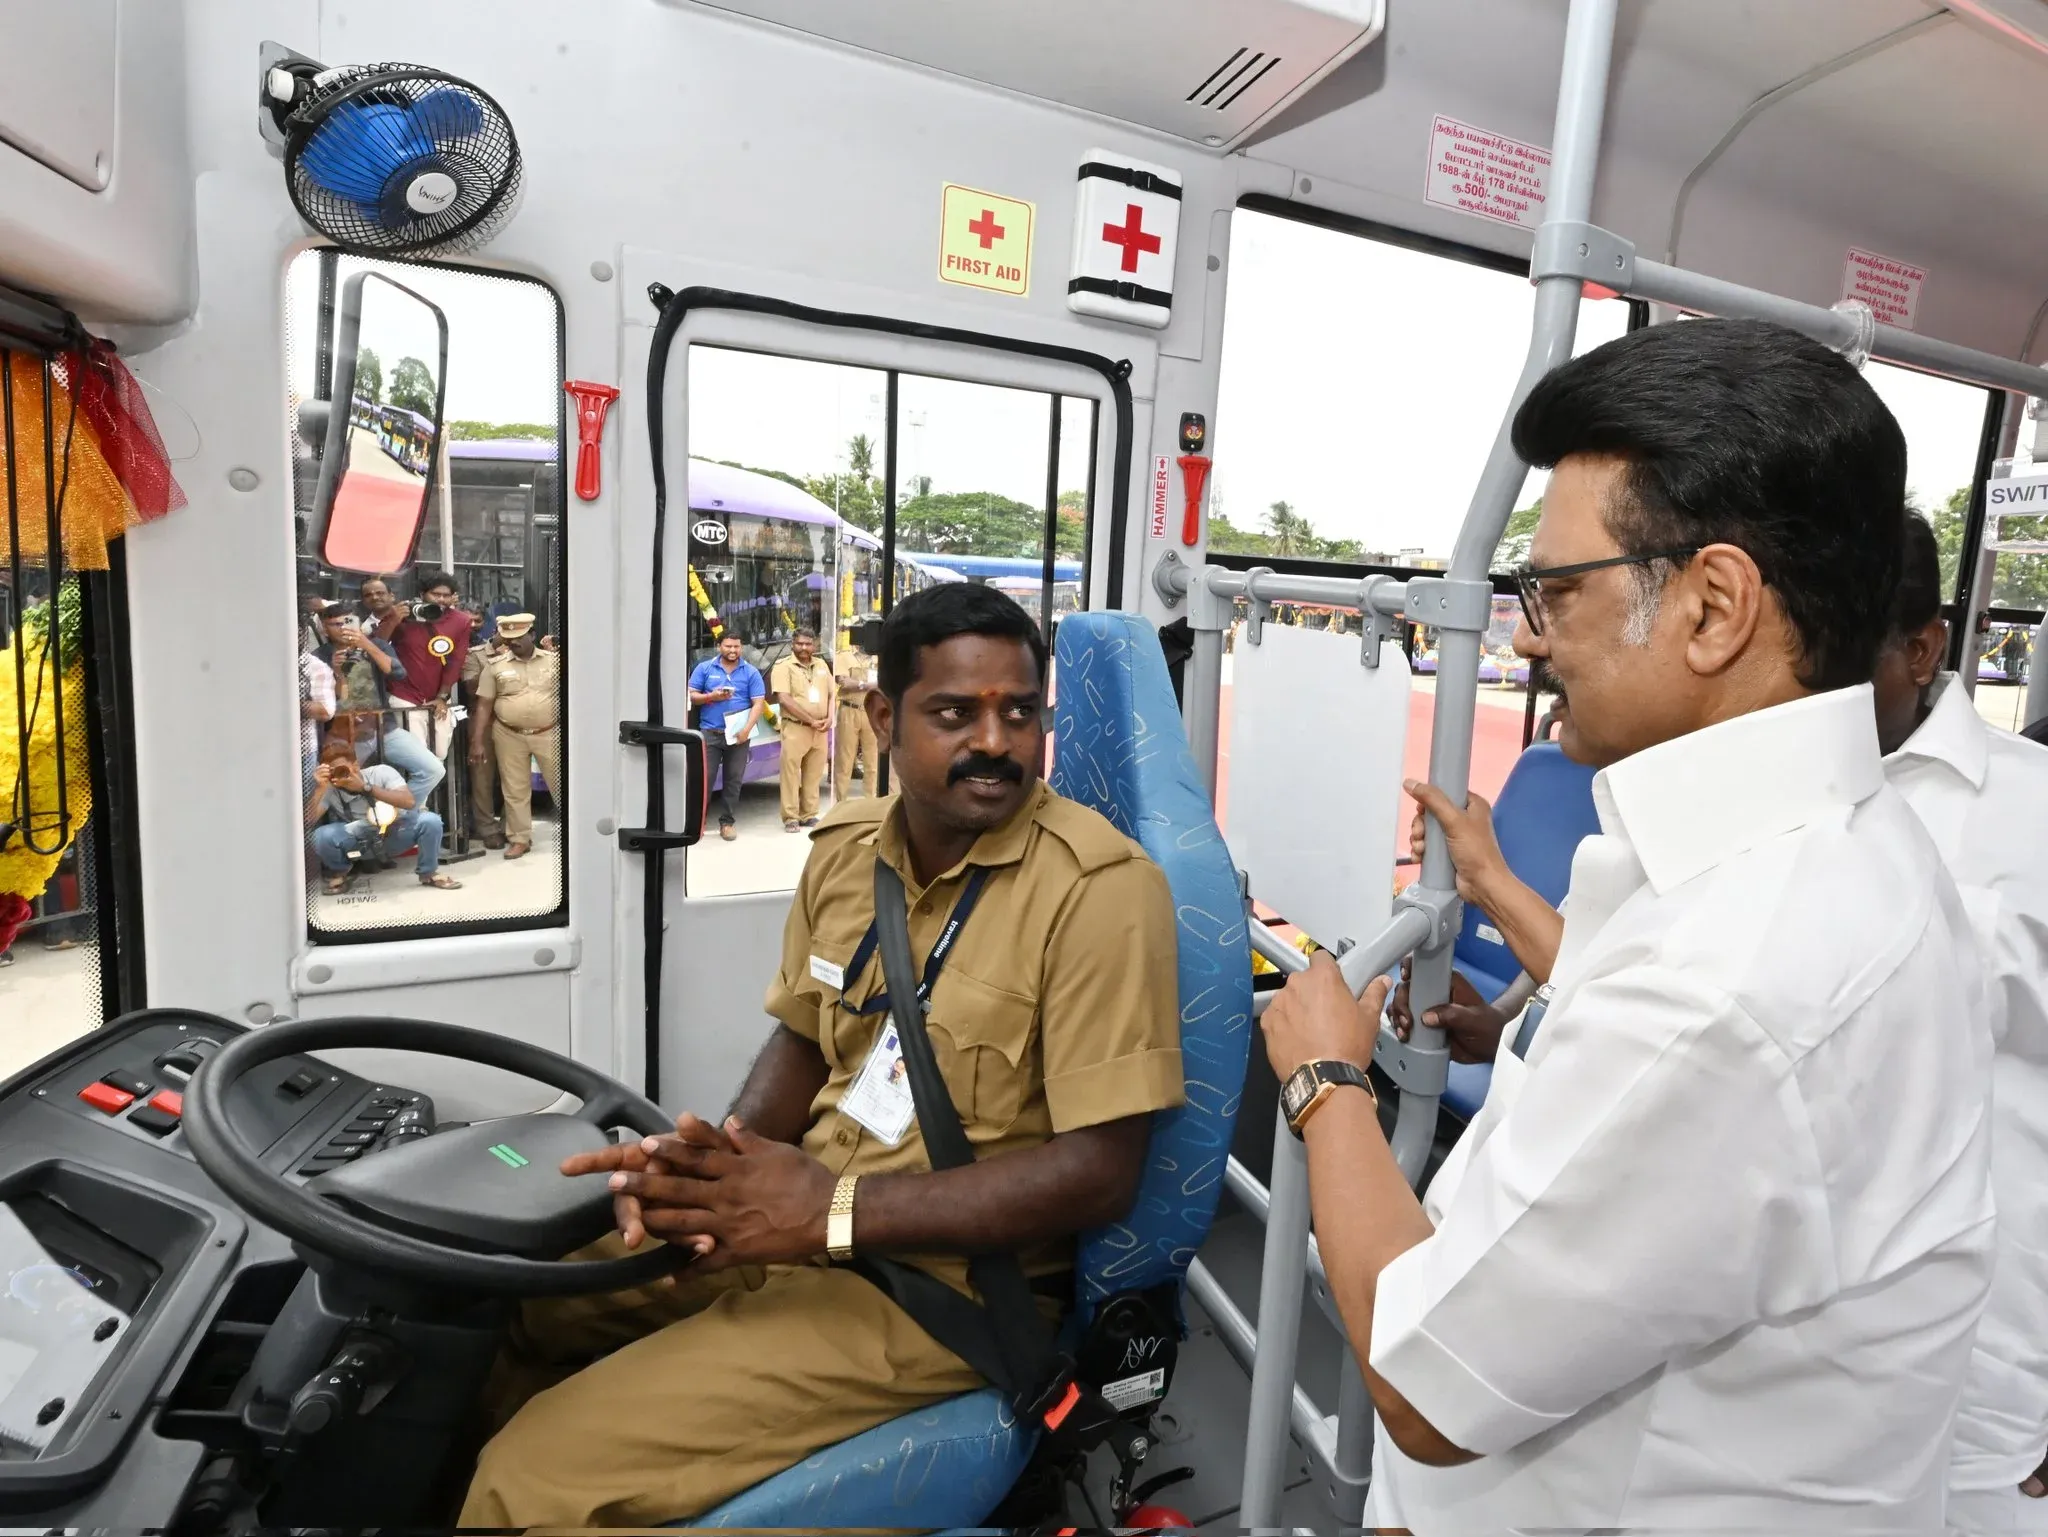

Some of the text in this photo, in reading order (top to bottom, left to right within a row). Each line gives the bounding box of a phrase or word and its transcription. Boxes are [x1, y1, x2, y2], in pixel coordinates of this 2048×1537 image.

[1454, 142, 1486, 158] பயணம்
[1488, 176, 1505, 190] 178
[946, 254, 1021, 282] FIRST AID
[1153, 470, 1167, 536] HAMMER
[697, 524, 725, 540] MTC
[934, 920, 958, 958] traveltime
